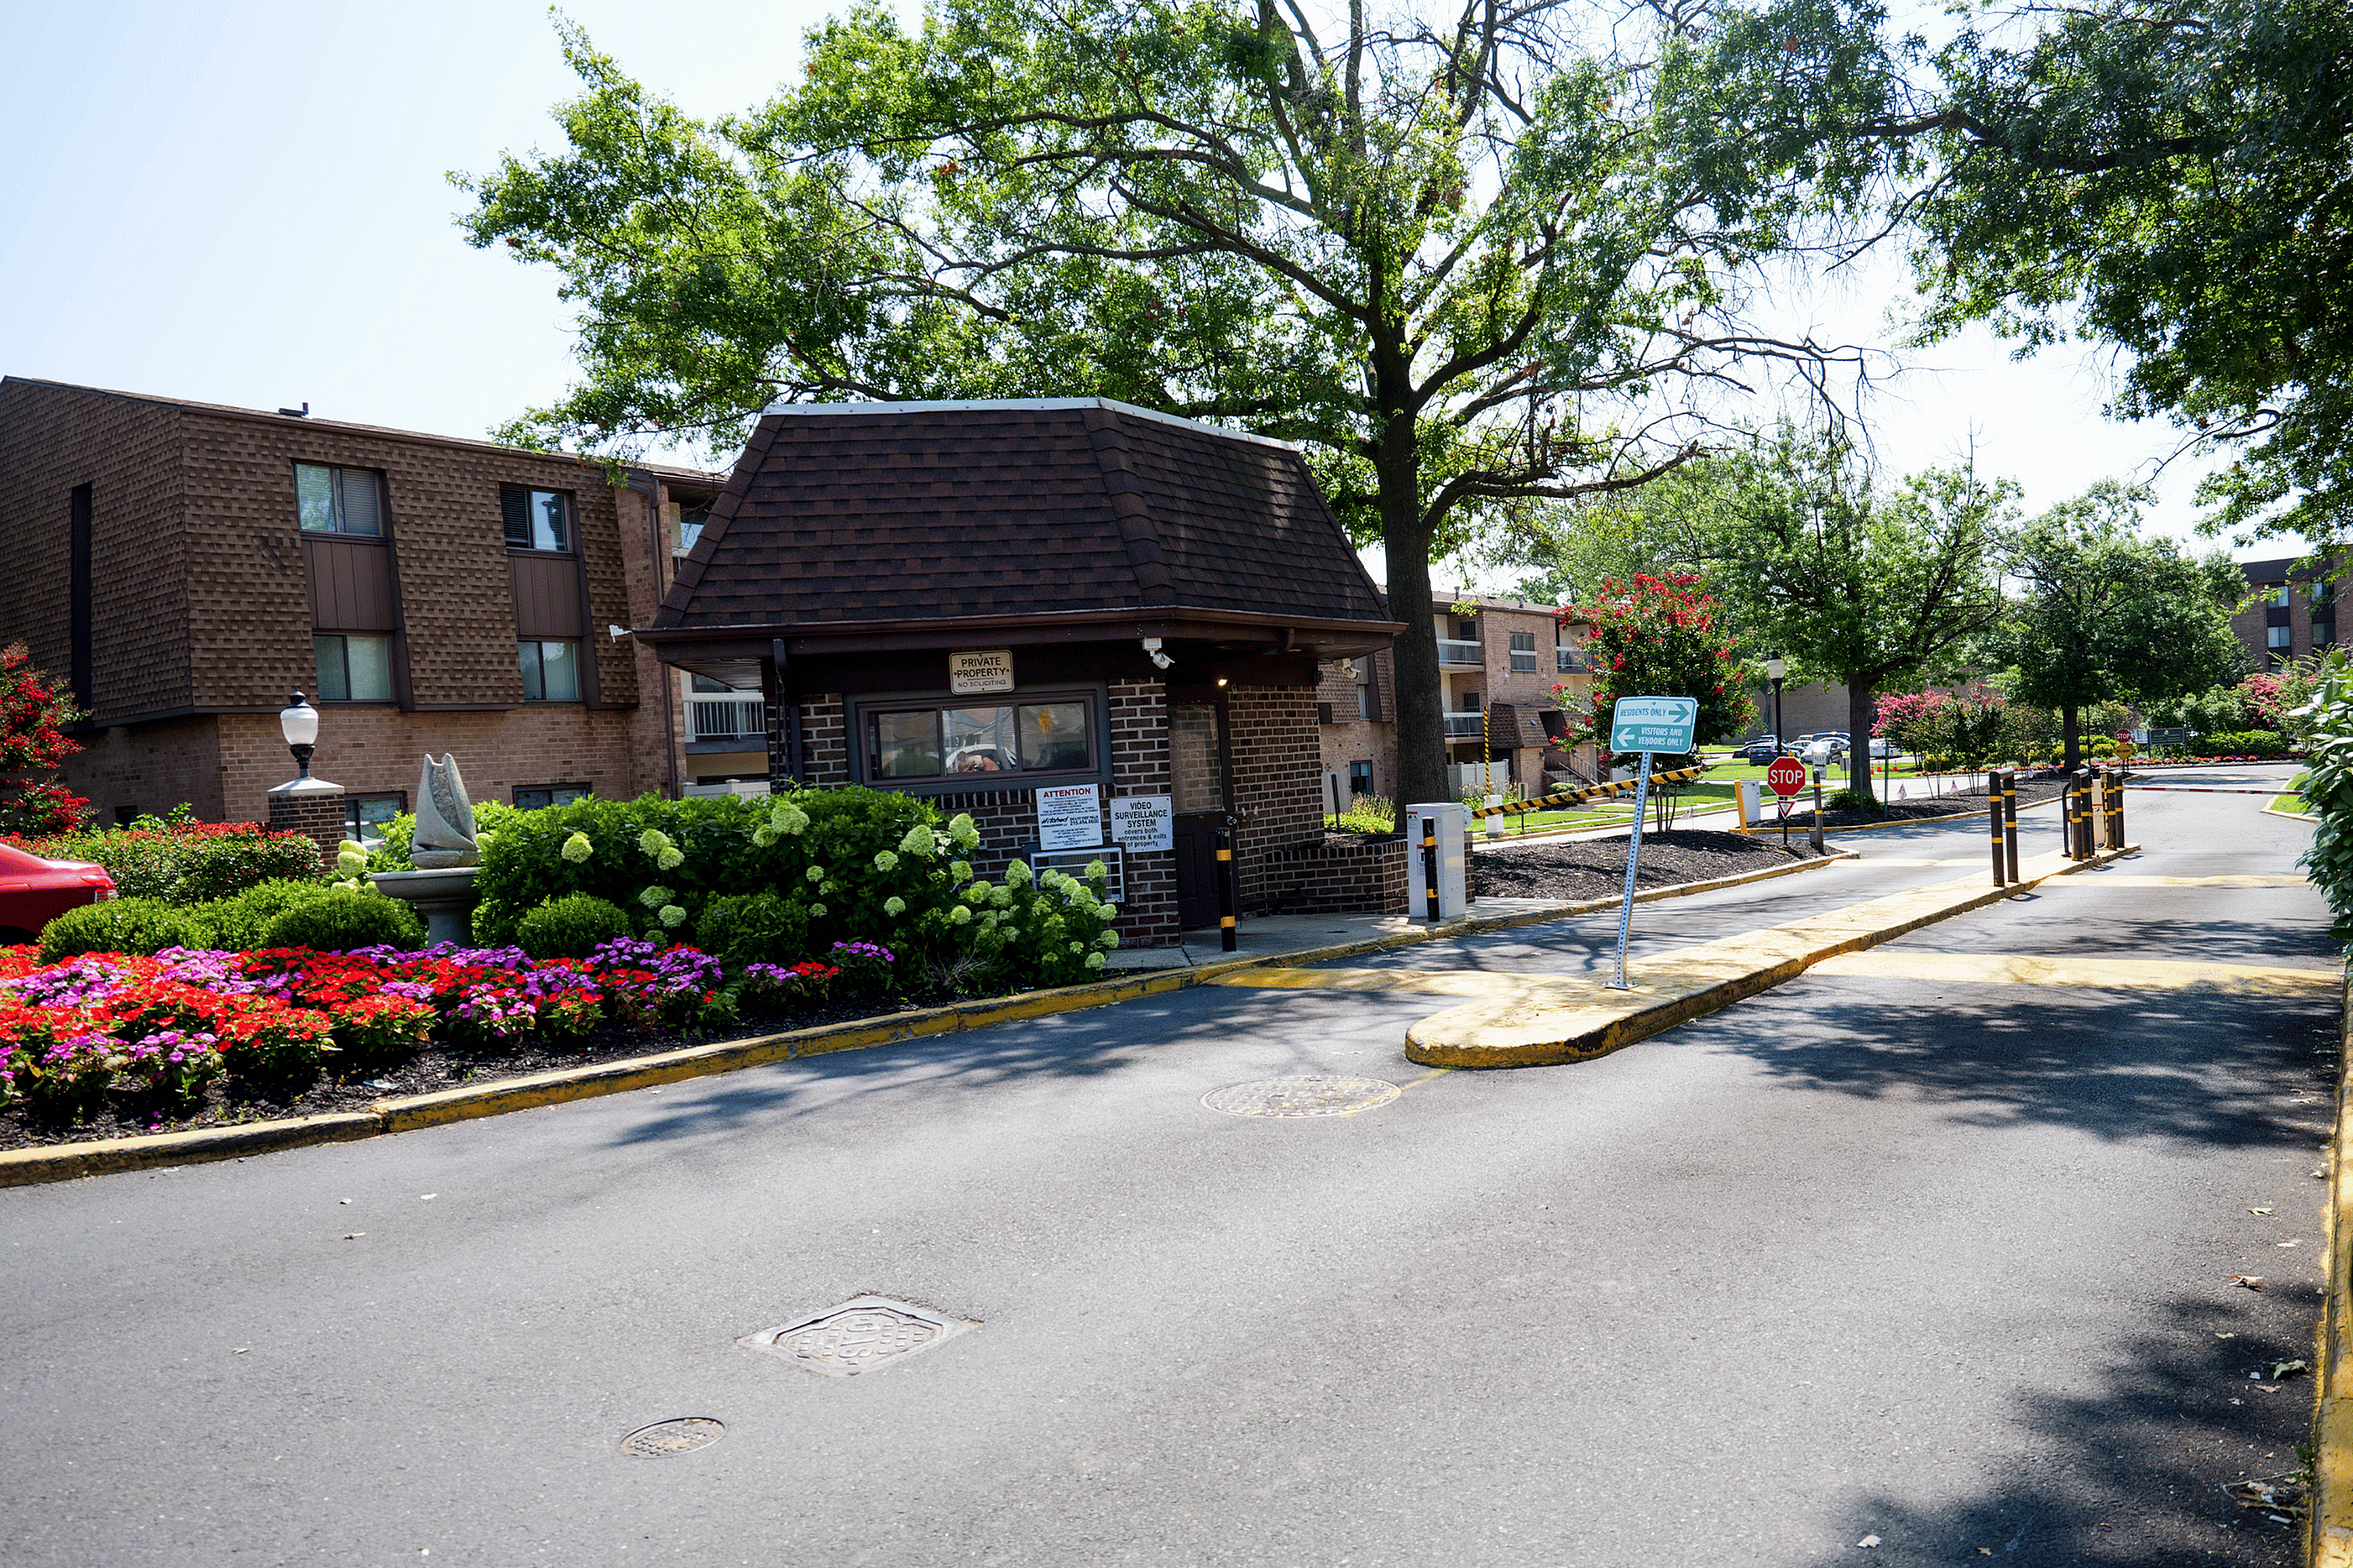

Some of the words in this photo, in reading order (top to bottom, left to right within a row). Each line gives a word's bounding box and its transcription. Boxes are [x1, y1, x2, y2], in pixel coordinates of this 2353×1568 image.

[961, 657, 1001, 667] PRIVATE
[957, 667, 1006, 678] PROPERTY
[1620, 708, 1649, 716] RESIDENTS
[1641, 727, 1668, 735] VISITORS
[1669, 728, 1683, 736] AND
[1638, 737, 1665, 745] VENDORS
[1666, 738, 1684, 746] ONLY
[1770, 770, 1803, 784] STOP
[1043, 787, 1091, 798] ATTENTION
[1130, 802, 1152, 810] VIDEO
[1115, 809, 1168, 819] SURVEILLANCE
[1127, 819, 1157, 828] SYSTEM
